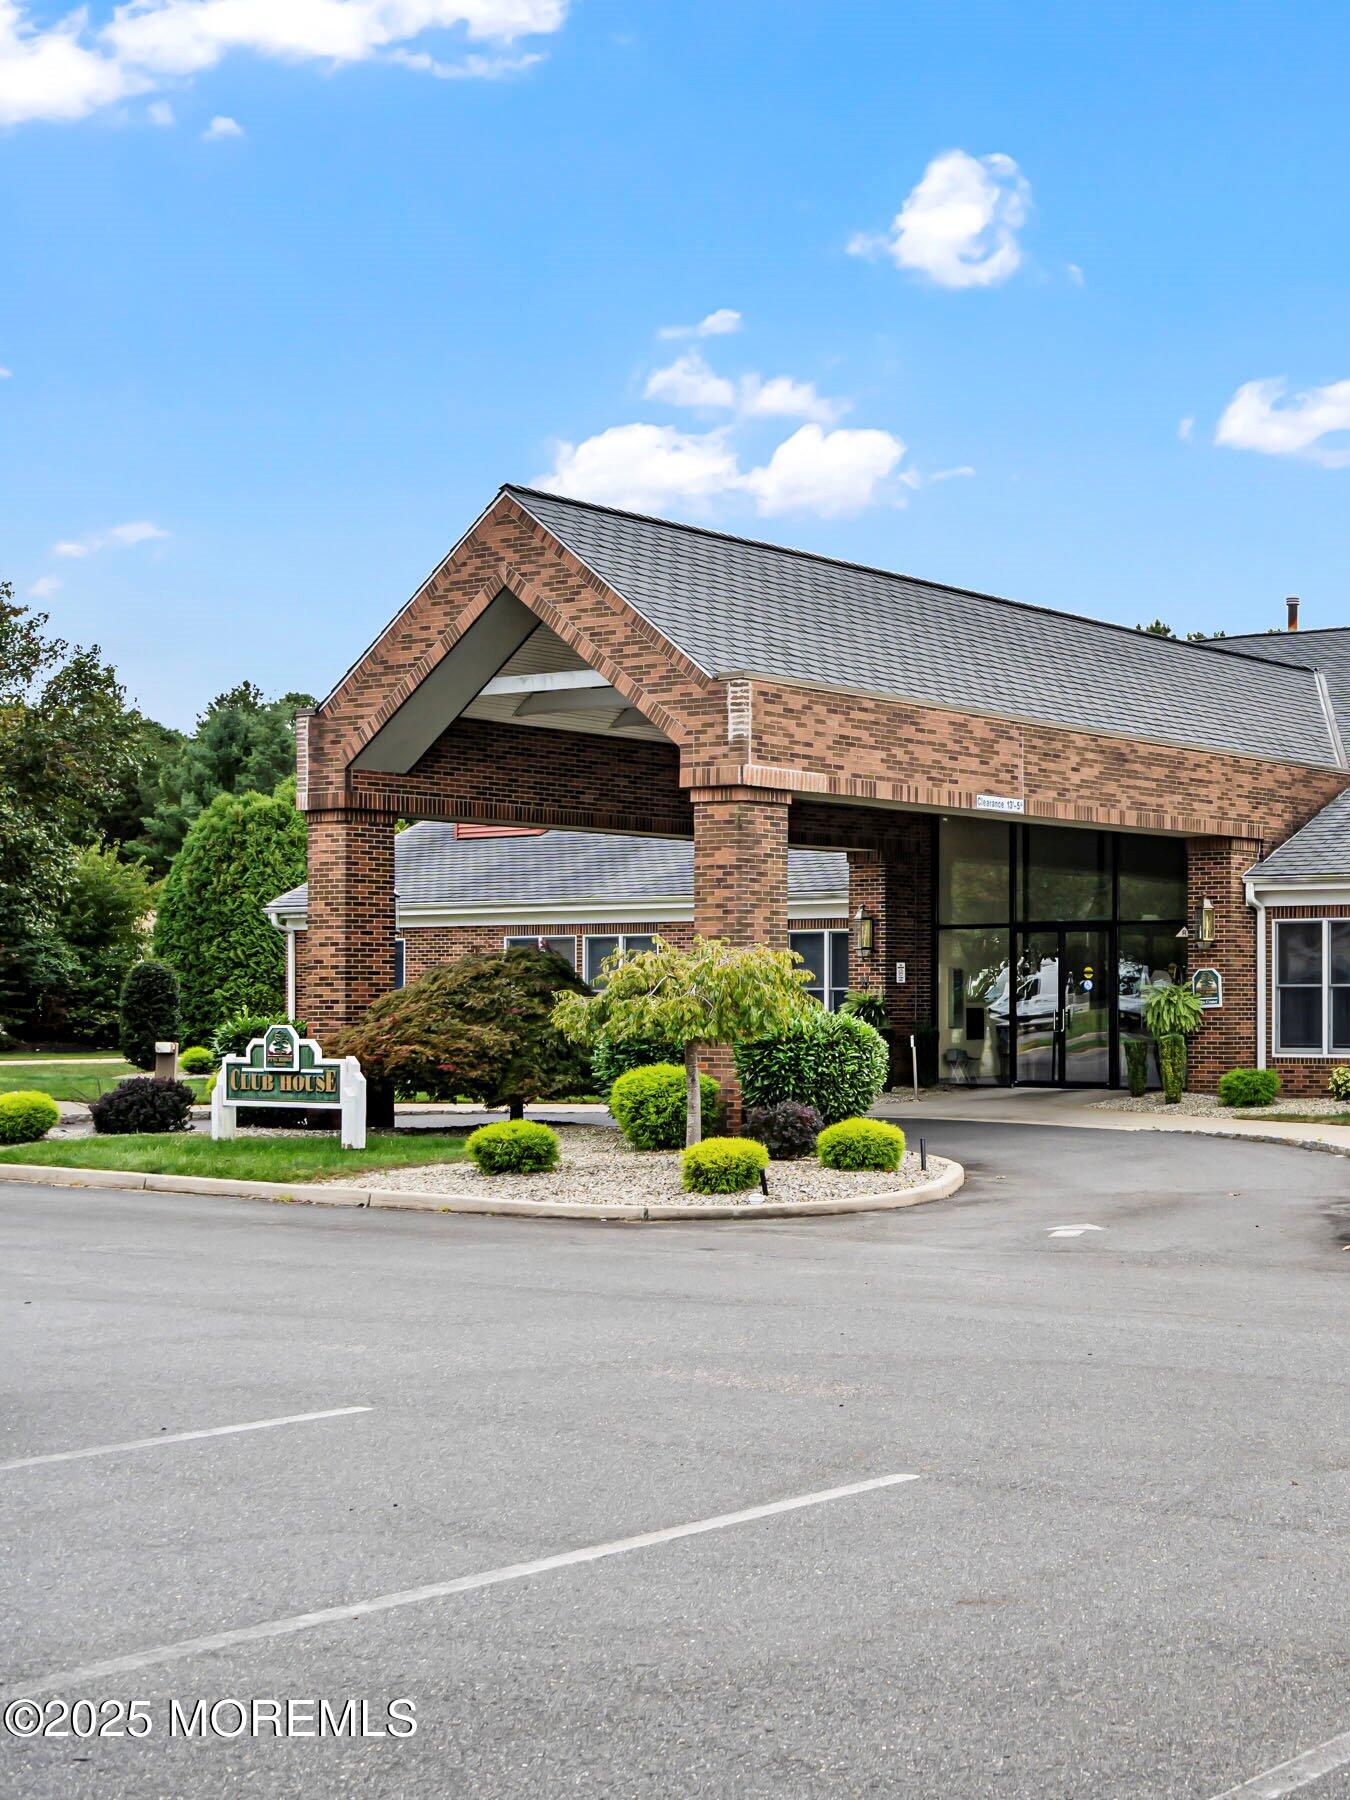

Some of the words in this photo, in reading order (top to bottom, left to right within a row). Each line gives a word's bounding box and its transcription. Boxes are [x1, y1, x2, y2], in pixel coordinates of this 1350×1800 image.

[977, 797, 1004, 809] Clearance
[230, 1068, 275, 1092] CLUB
[279, 1069, 337, 1094] HOUSE
